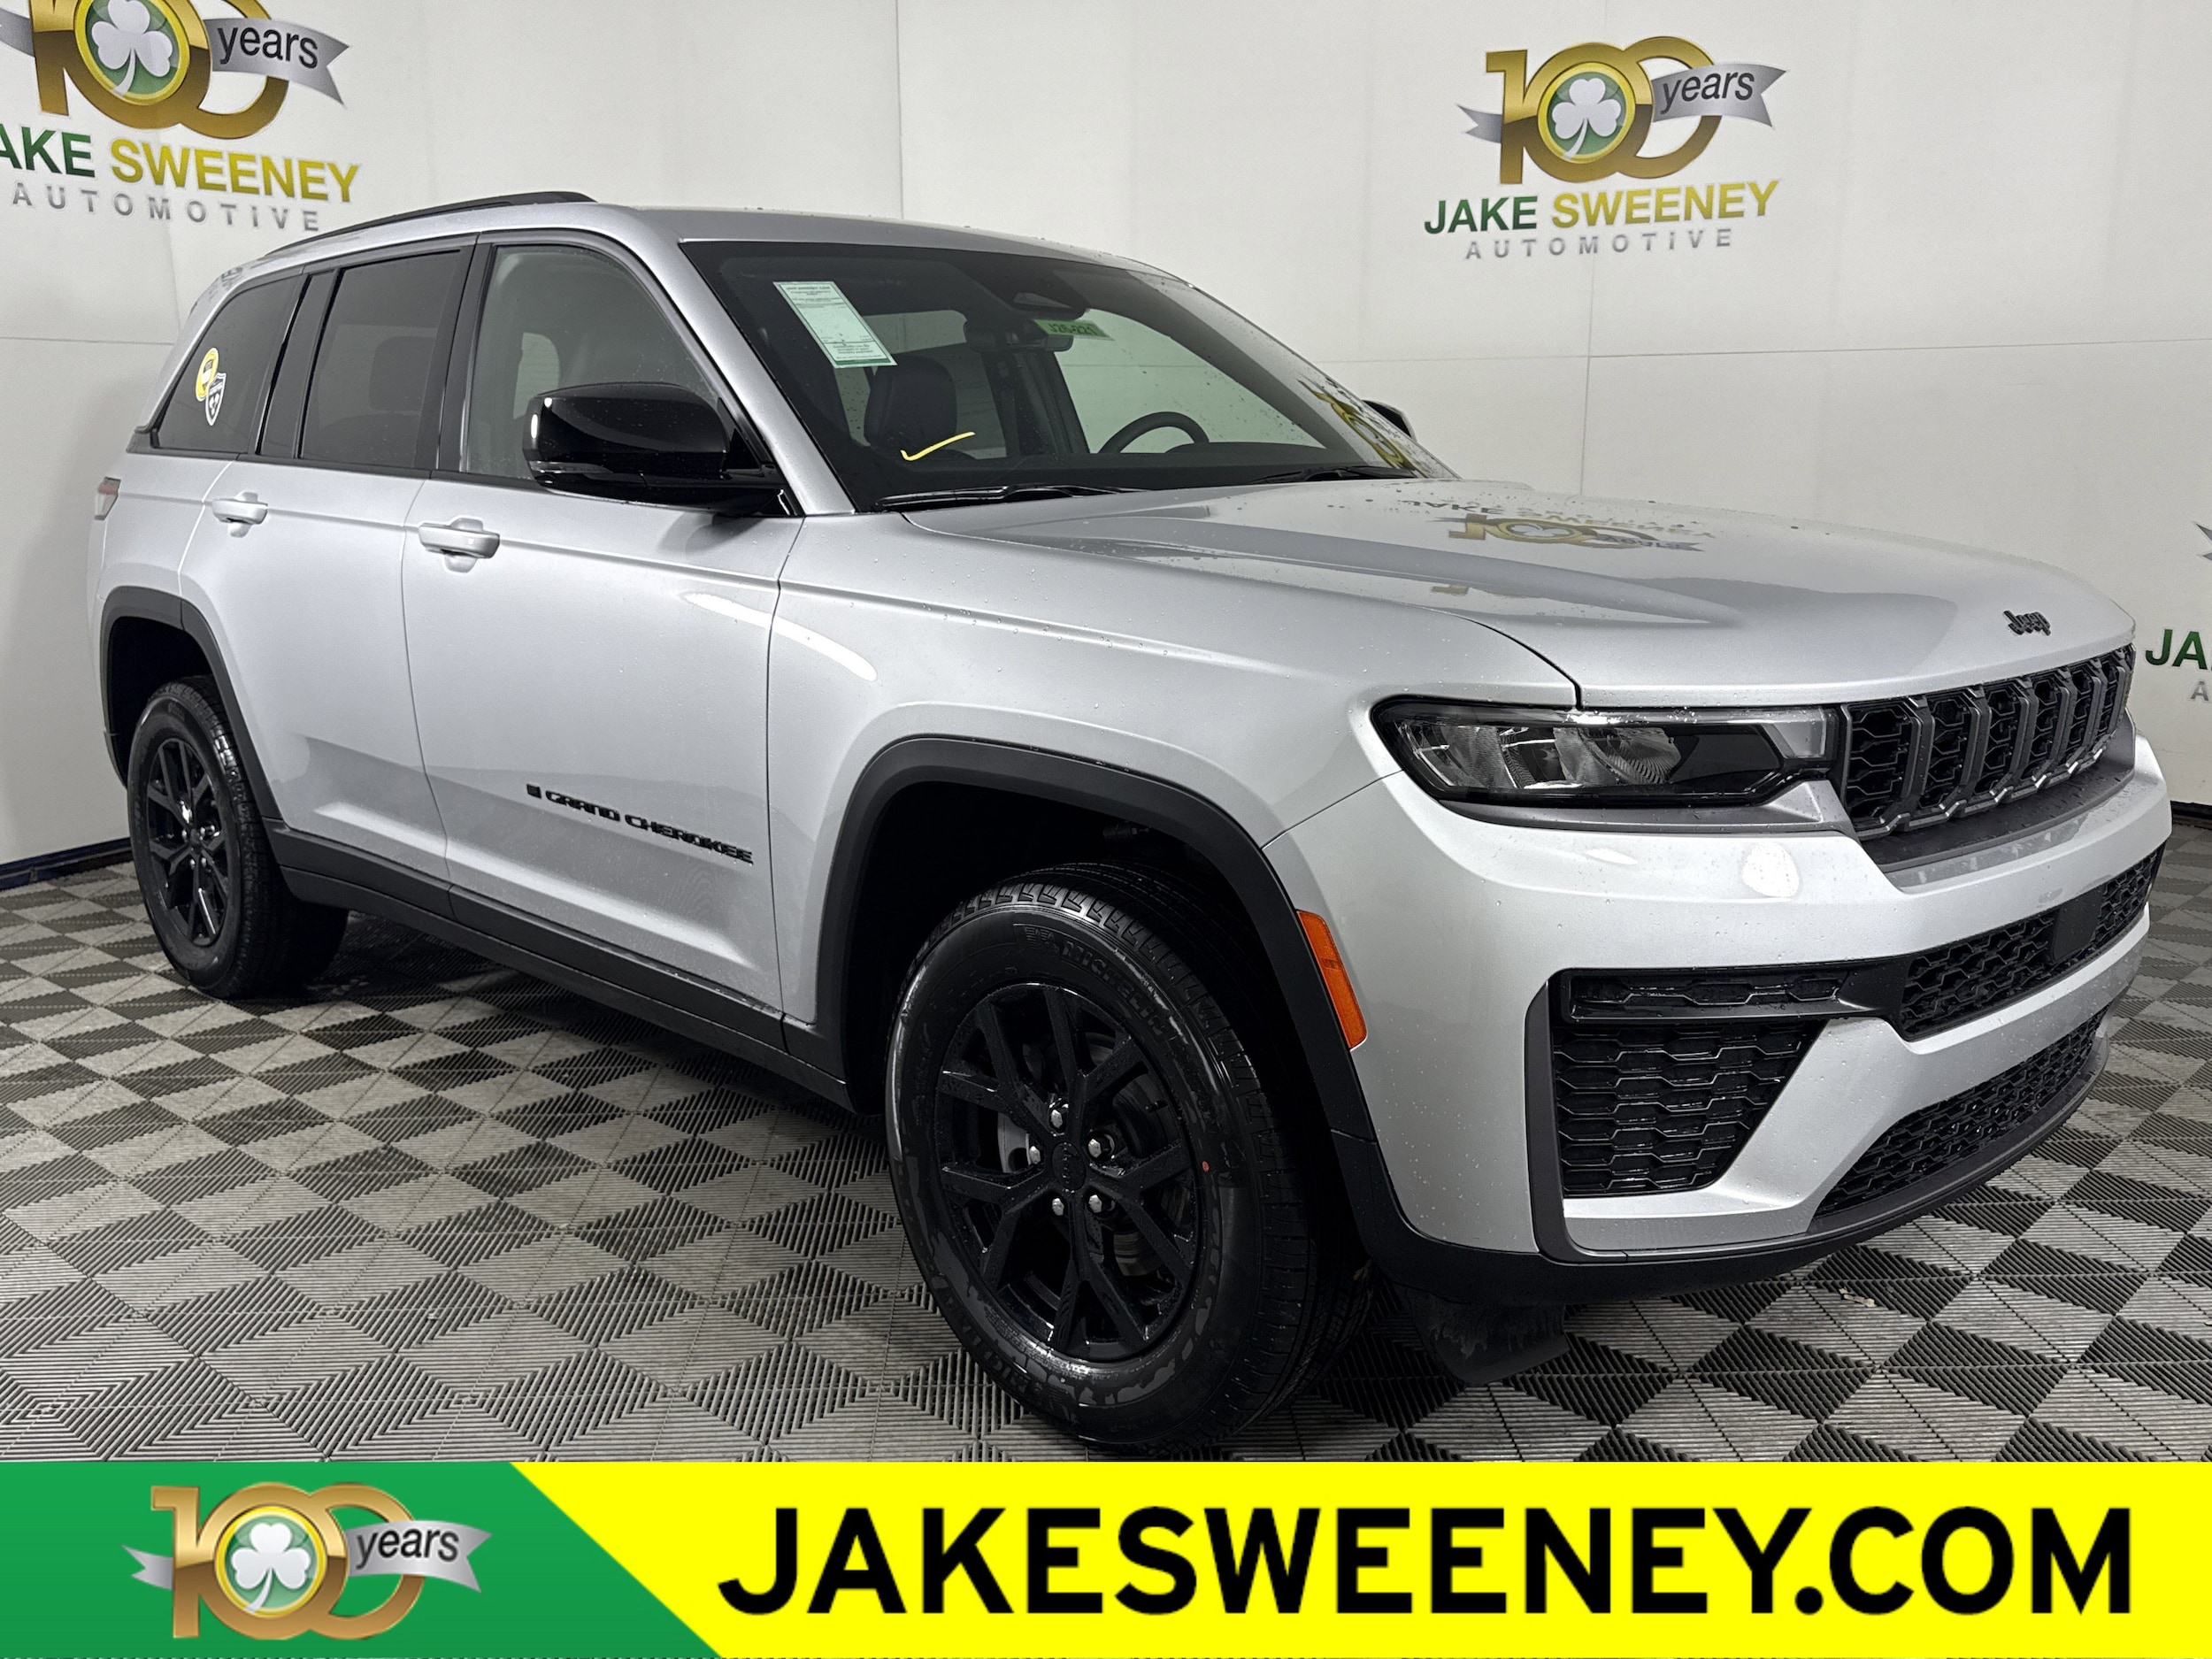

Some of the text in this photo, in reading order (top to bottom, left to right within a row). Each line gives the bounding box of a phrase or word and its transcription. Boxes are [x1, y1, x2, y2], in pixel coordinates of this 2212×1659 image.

[217, 27, 319, 70] years
[1486, 36, 1755, 184] 100 years
[111, 138, 359, 203] SWEENEY
[12, 182, 320, 232] AUTOMOTIVE
[1424, 180, 1779, 234] JAKE SWEENEY
[1465, 228, 1732, 259] AUTOMOTIVE
[2002, 610, 2051, 636] Jeep
[2145, 628, 2212, 670] JA
[545, 790, 755, 864] GRAND CHEROKEE
